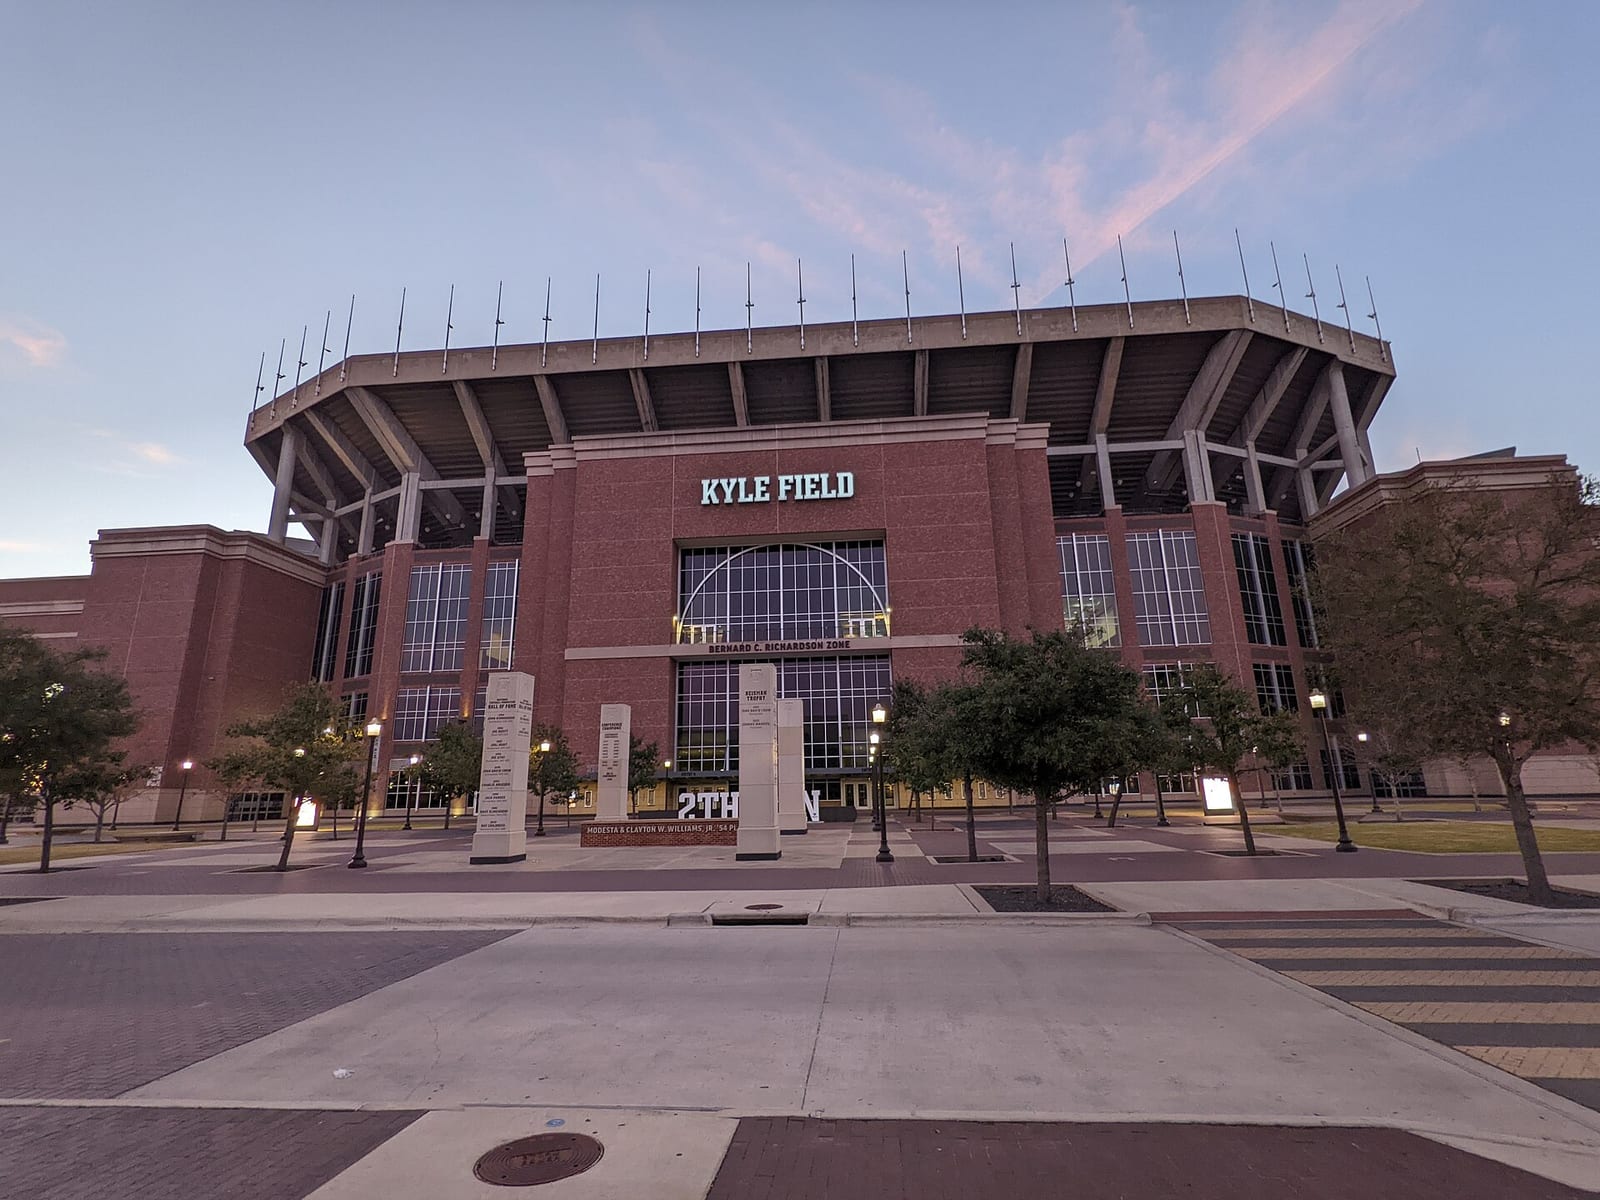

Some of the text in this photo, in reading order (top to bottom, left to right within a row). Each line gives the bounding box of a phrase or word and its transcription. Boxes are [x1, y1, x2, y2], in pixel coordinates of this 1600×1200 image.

[701, 472, 854, 505] KYLE FIELD
[709, 640, 850, 653] BERNARD C. RICHARDSON ZONE
[586, 826, 619, 834] MODESTA
[620, 826, 625, 834] &
[626, 825, 656, 833] CLAYTON
[657, 825, 667, 833] W.
[729, 823, 738, 832] PL
